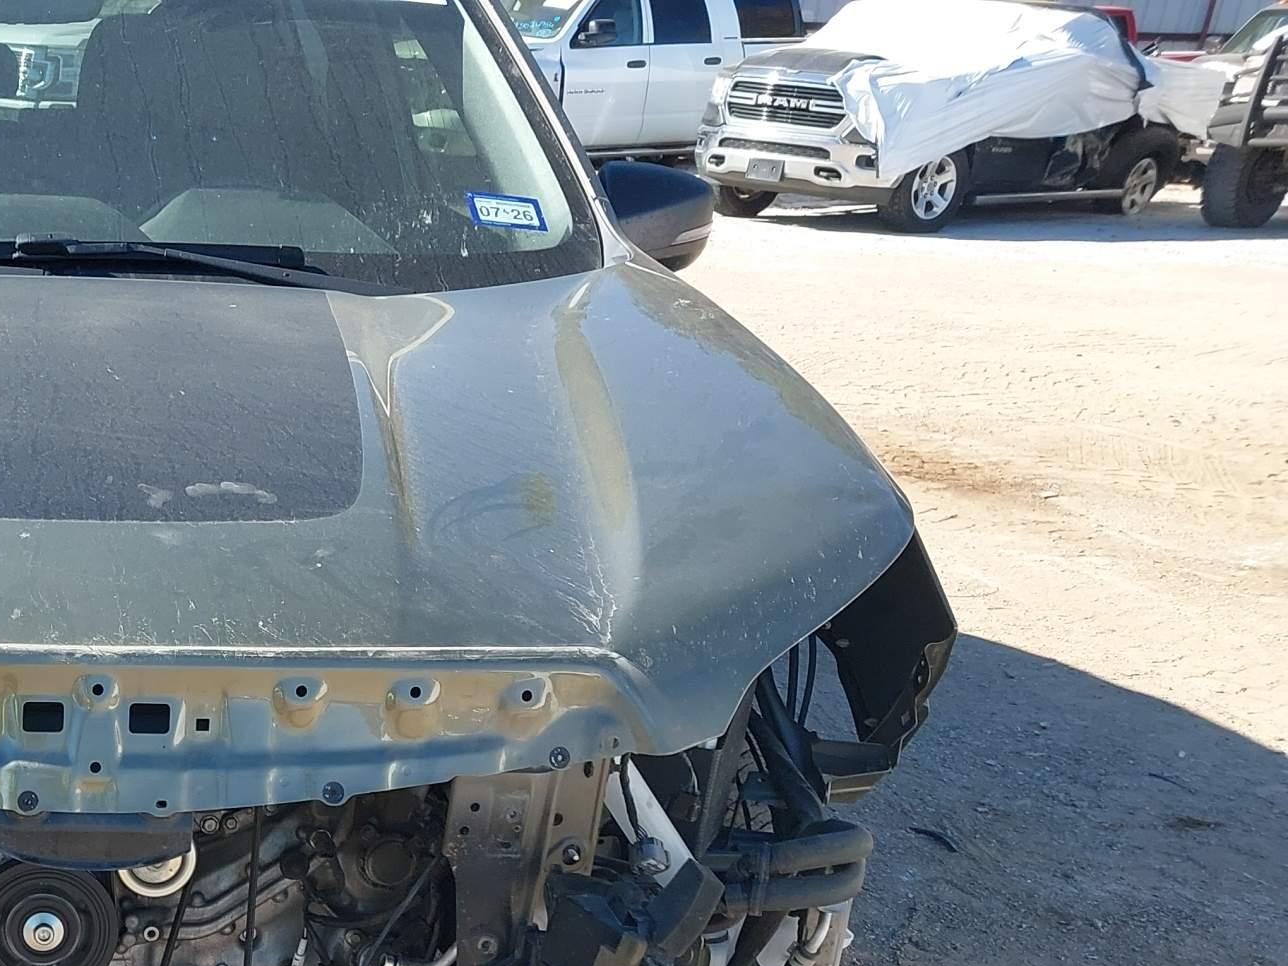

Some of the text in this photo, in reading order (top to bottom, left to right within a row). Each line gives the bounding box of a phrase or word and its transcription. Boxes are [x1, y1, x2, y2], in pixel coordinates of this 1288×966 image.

[757, 93, 808, 110] RAM
[479, 205, 534, 222] 07 26
